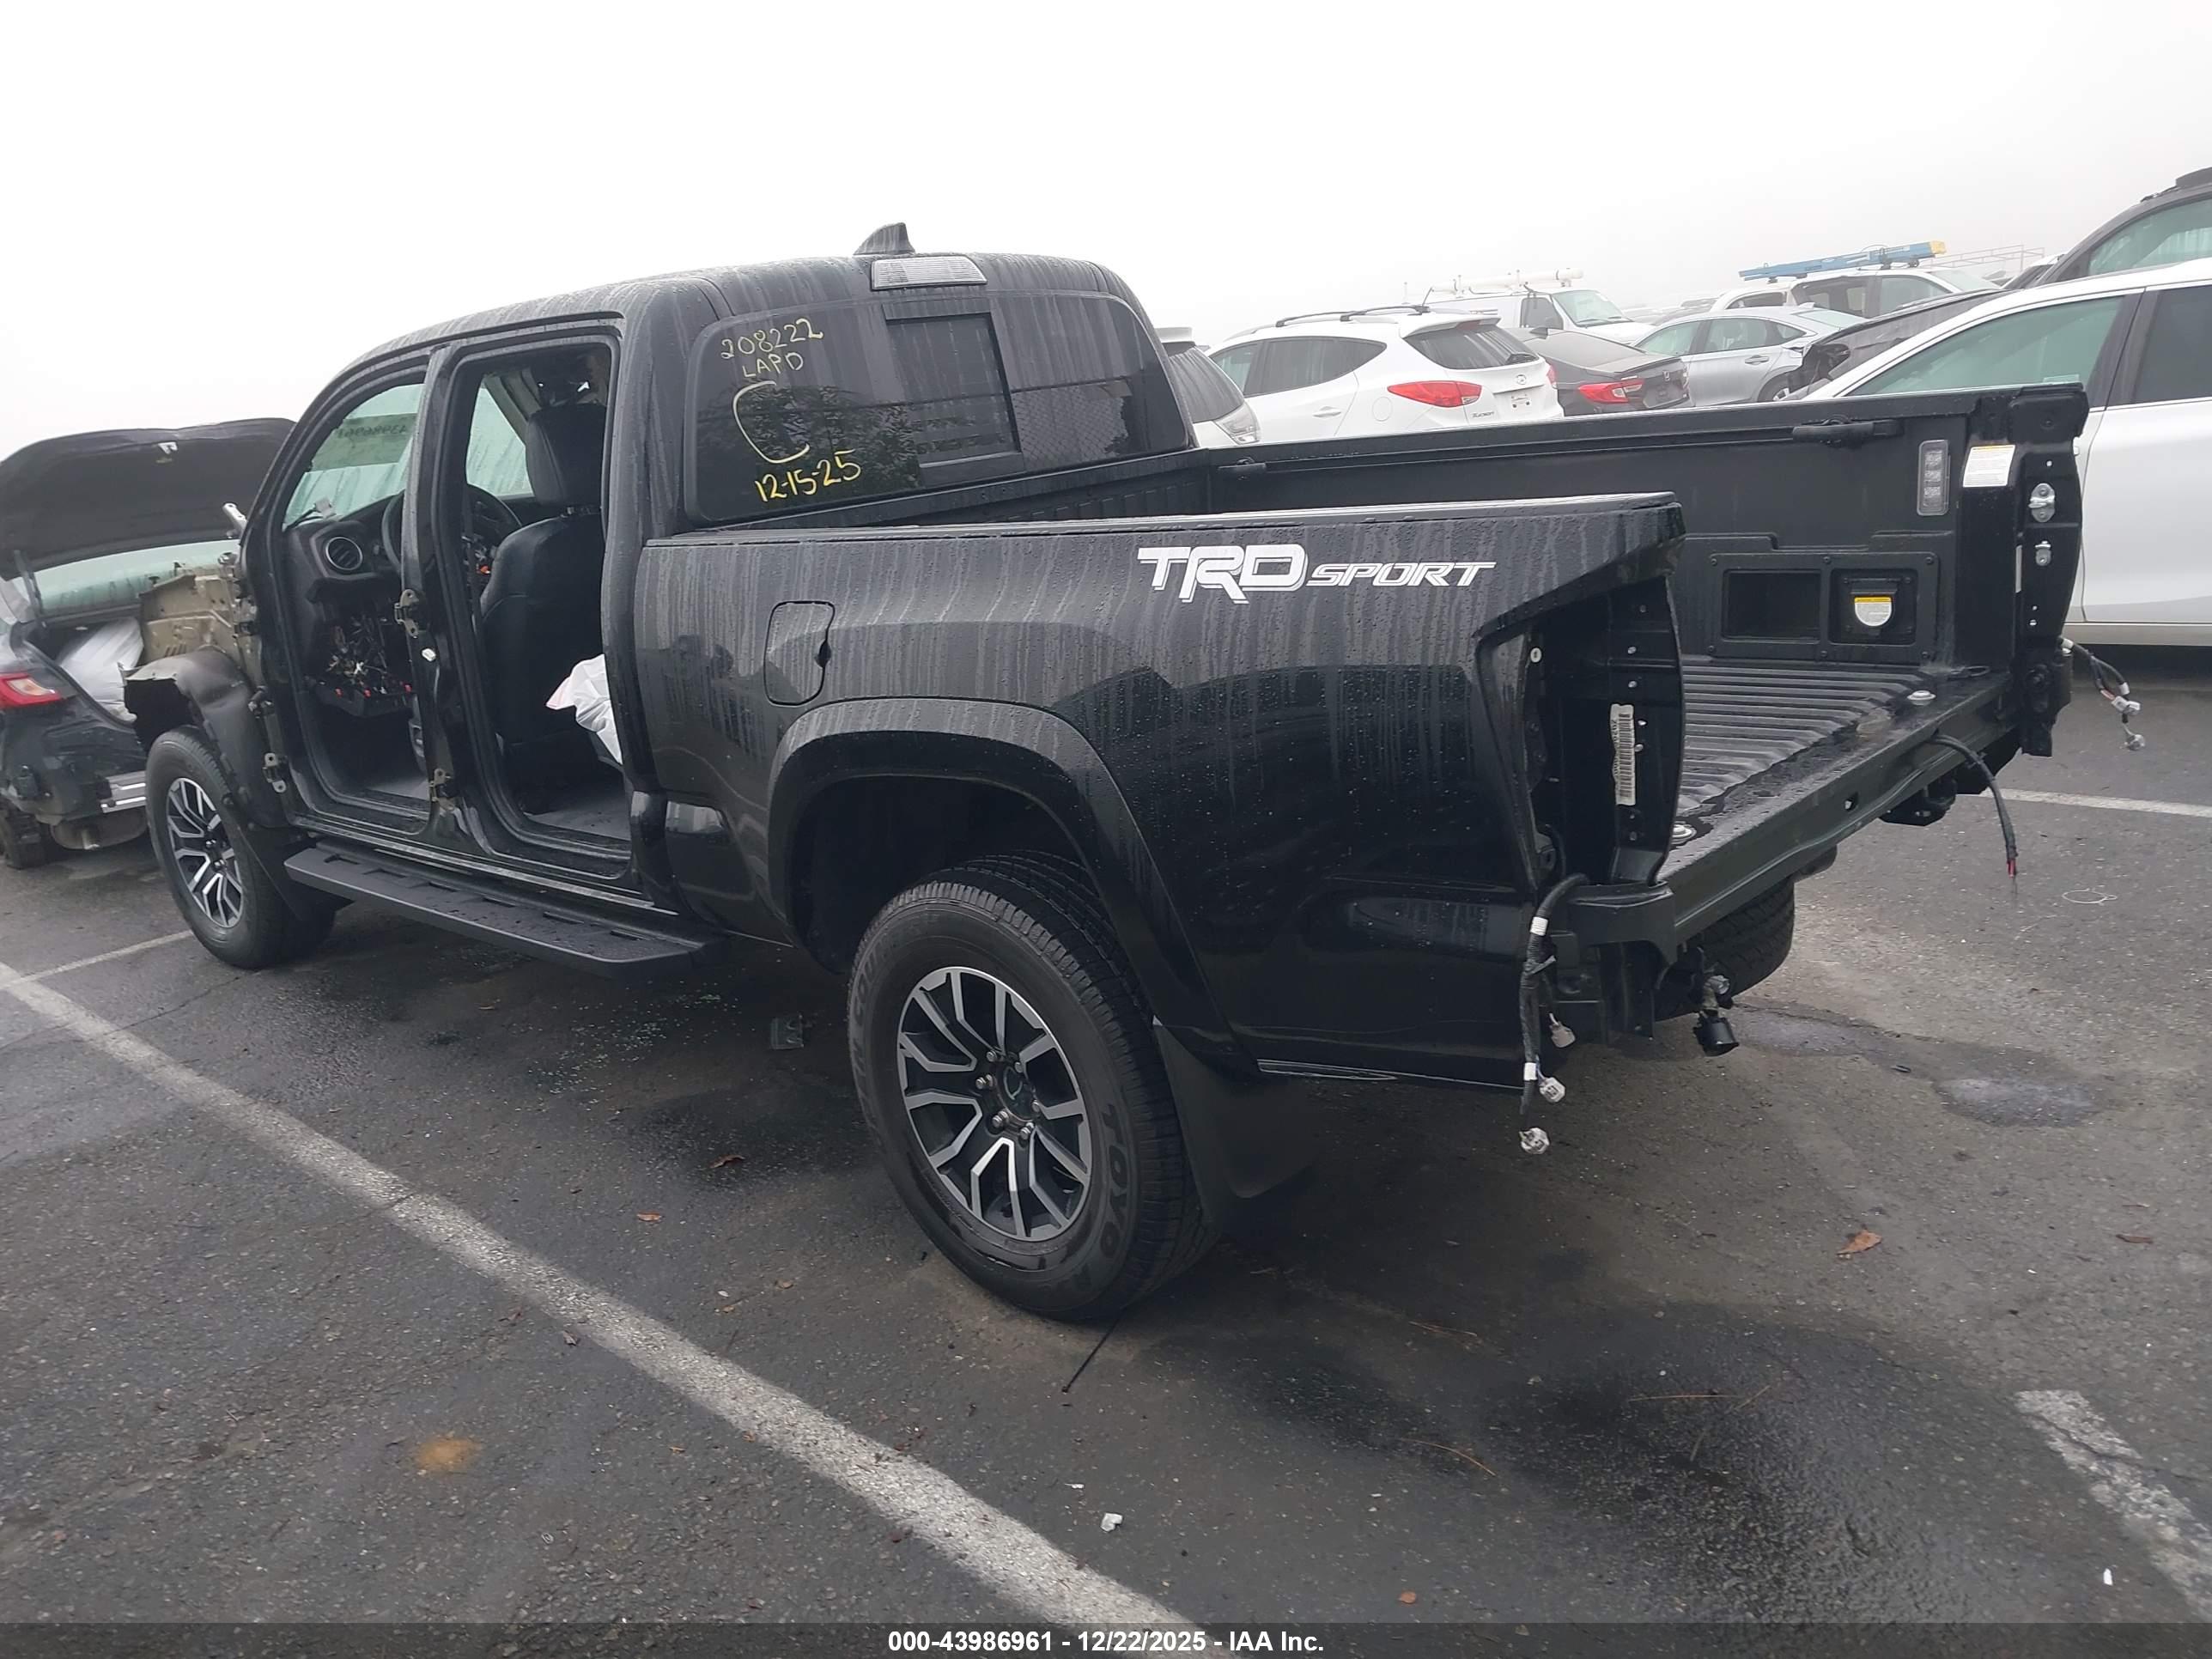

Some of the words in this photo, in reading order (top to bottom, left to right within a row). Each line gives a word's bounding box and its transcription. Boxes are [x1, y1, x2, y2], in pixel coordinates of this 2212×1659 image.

[720, 318, 823, 359] 208222
[742, 352, 804, 378] LAPD
[754, 447, 861, 502] 12-15-25
[1137, 544, 1309, 605] TRD
[1306, 561, 1497, 586] SPORT
